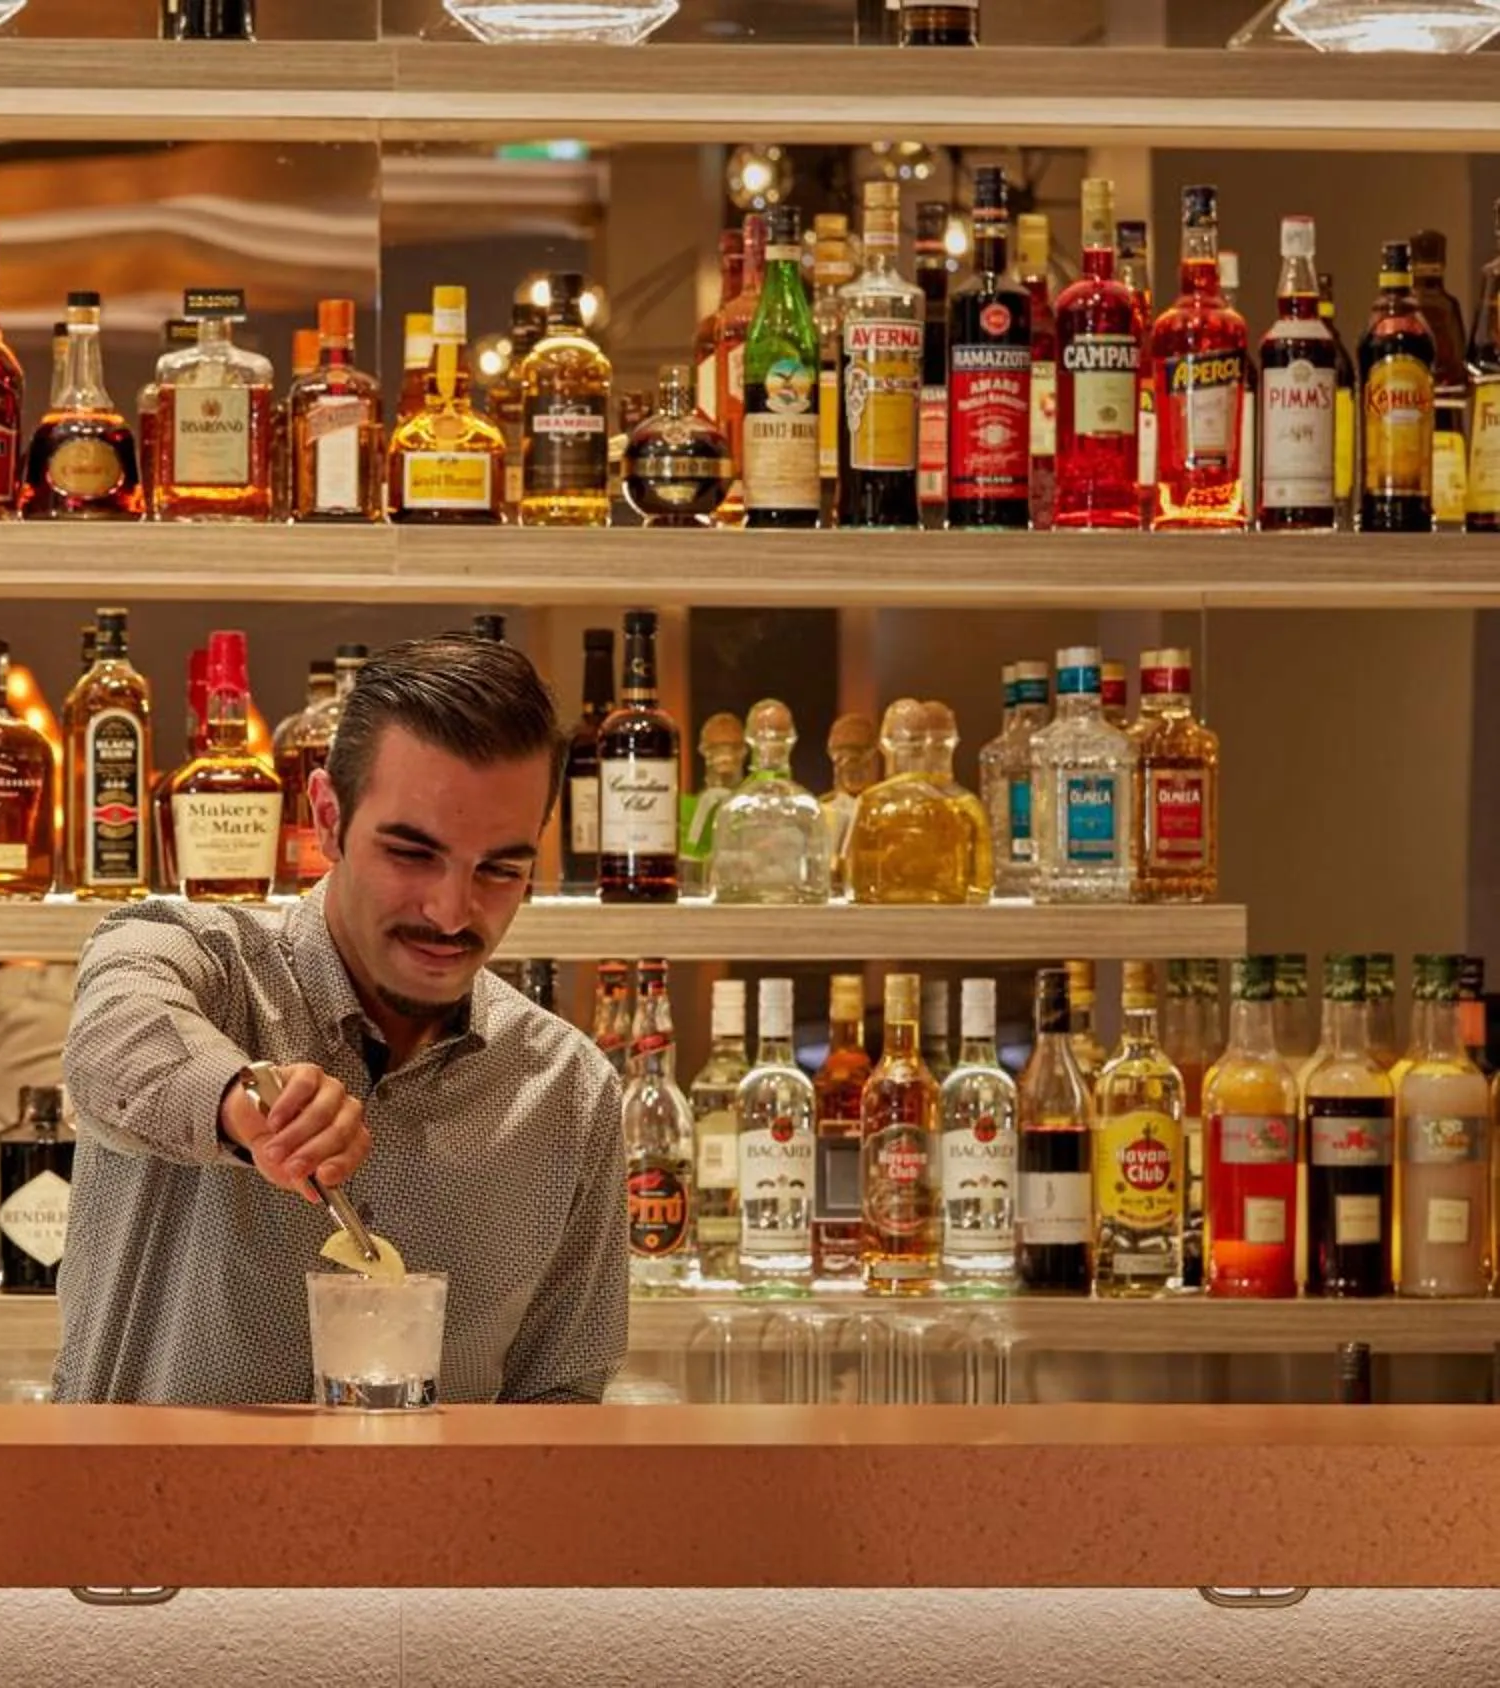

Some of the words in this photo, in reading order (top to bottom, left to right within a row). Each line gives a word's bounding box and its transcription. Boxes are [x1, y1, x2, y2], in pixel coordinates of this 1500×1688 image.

[1063, 345, 1141, 369] CAMPAR
[1172, 358, 1241, 387] APEROL
[1269, 383, 1332, 410] PIMM'S
[188, 802, 268, 817] Maker's
[212, 820, 267, 834] Mark
[888, 1163, 918, 1179] Club
[1127, 1164, 1165, 1183] Club
[2, 1209, 68, 1224] HENDRI
